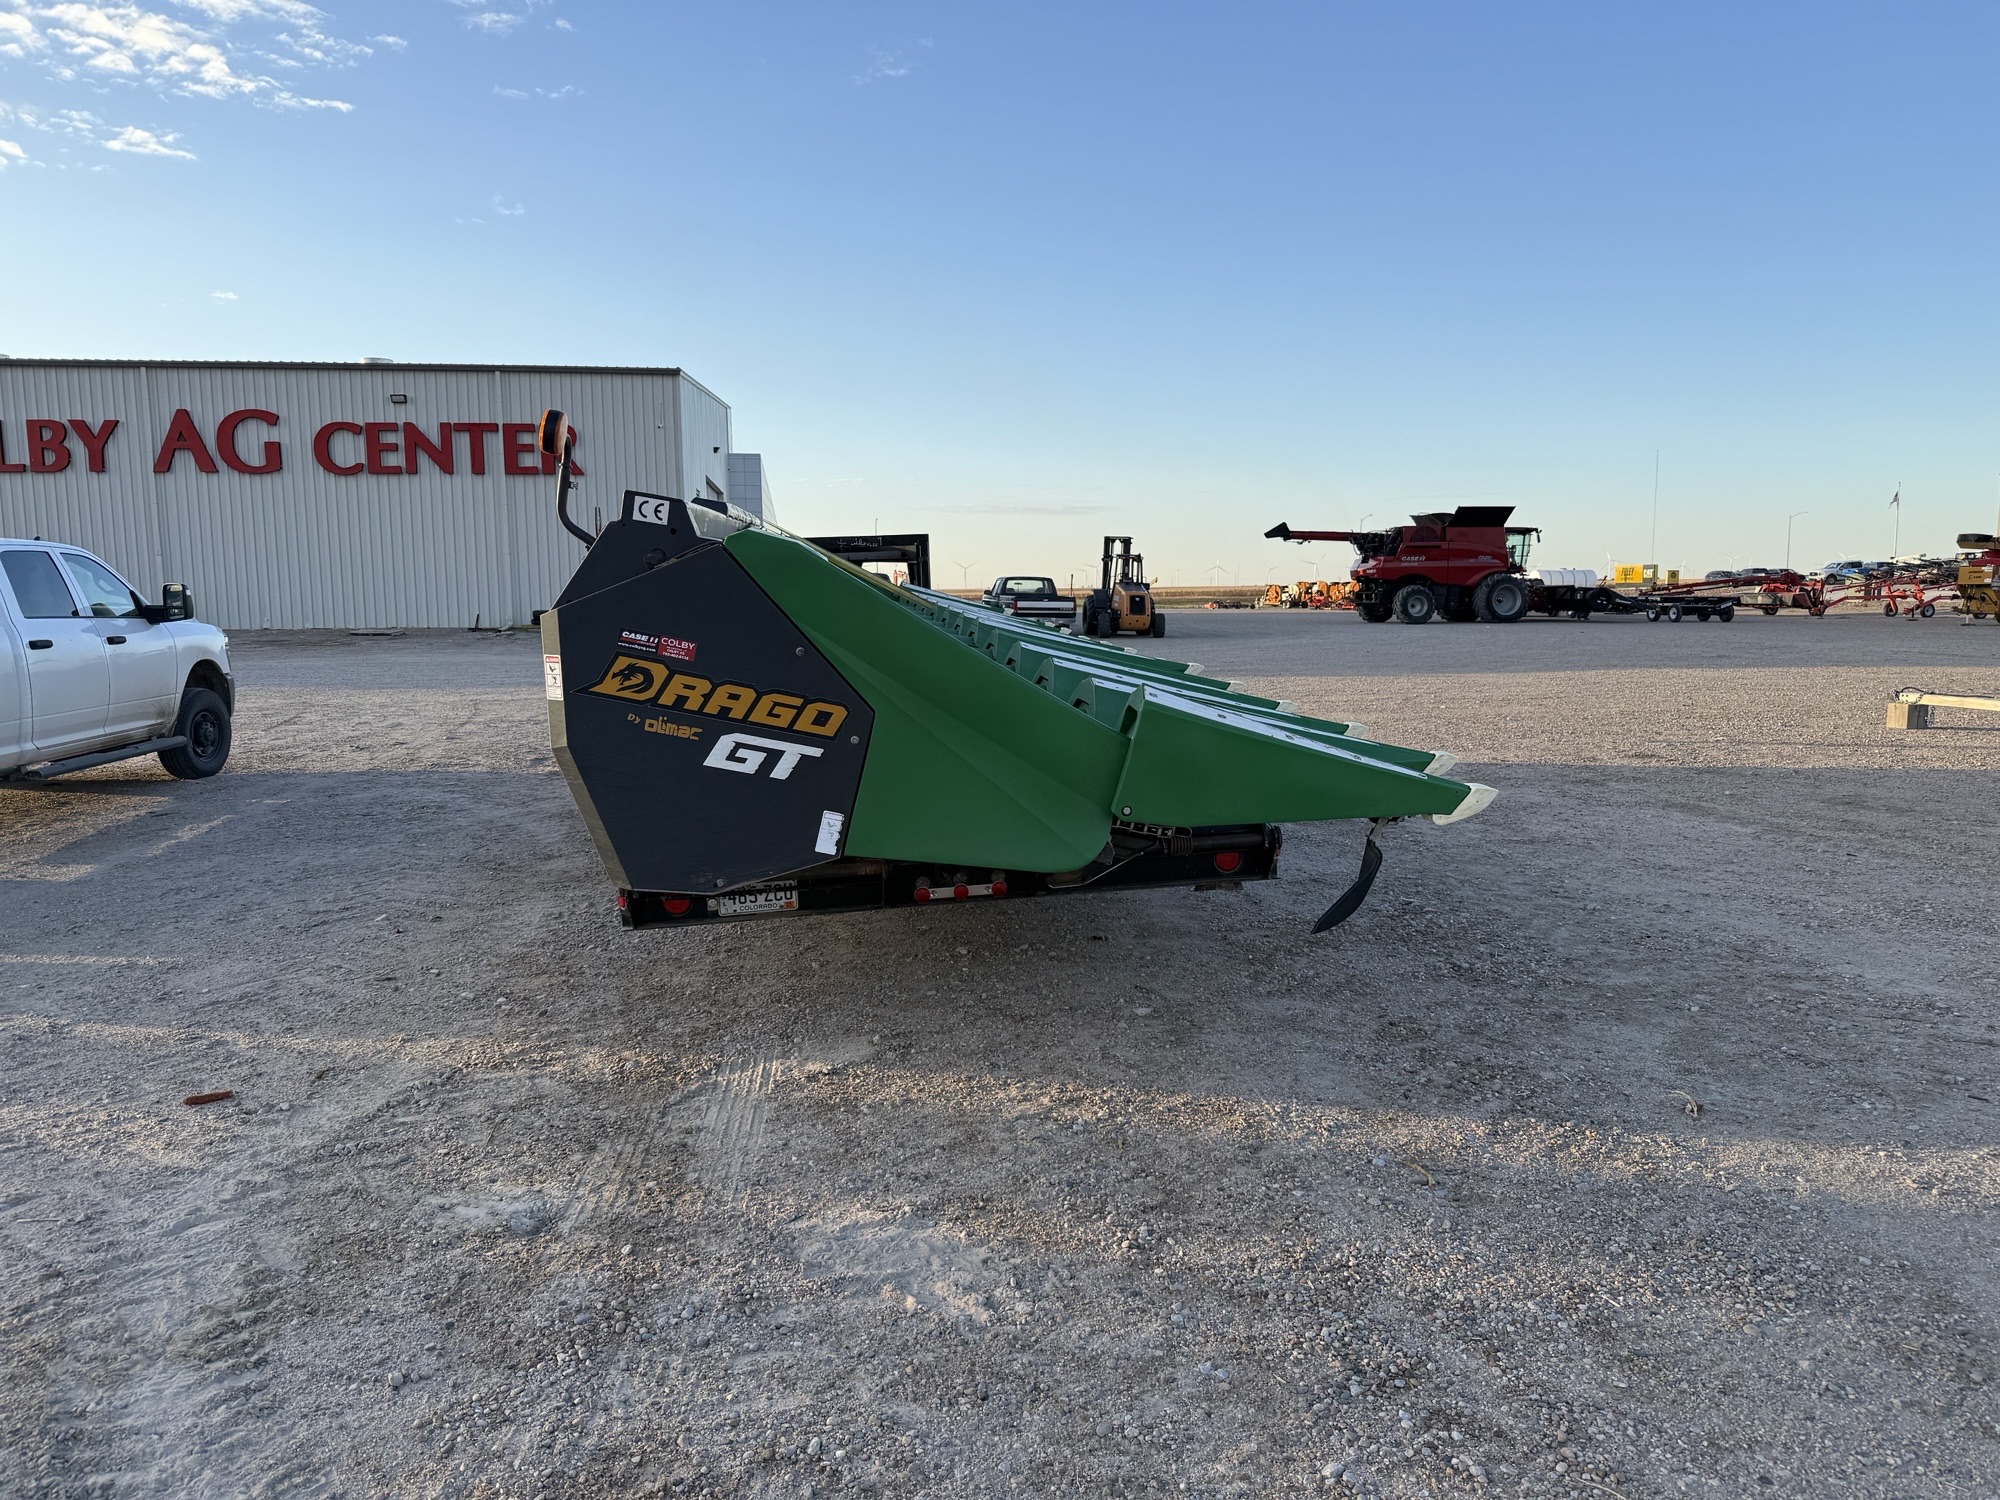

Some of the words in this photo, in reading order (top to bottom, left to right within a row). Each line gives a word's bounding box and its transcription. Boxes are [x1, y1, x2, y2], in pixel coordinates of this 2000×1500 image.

[153, 408, 283, 474] AG
[638, 500, 665, 521] CE
[622, 631, 649, 642] CASE
[661, 637, 696, 650] COLBY
[588, 655, 849, 737] DRAGO
[703, 732, 825, 780] GT
[739, 902, 778, 911] COLORADO
